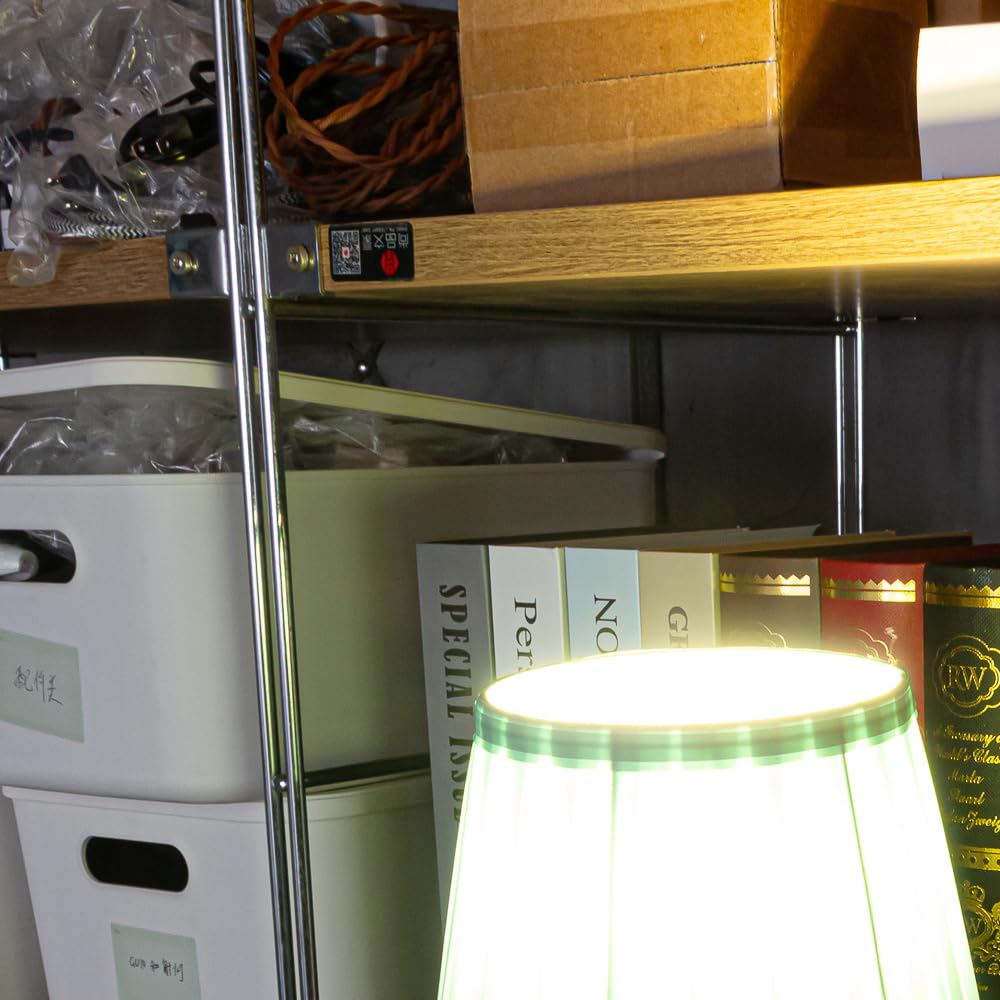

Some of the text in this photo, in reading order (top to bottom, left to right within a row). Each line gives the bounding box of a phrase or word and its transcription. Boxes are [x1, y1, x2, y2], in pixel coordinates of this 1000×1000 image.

[439, 584, 473, 719] SPECIAL
[514, 596, 537, 671] Per
[947, 665, 988, 691] RW
